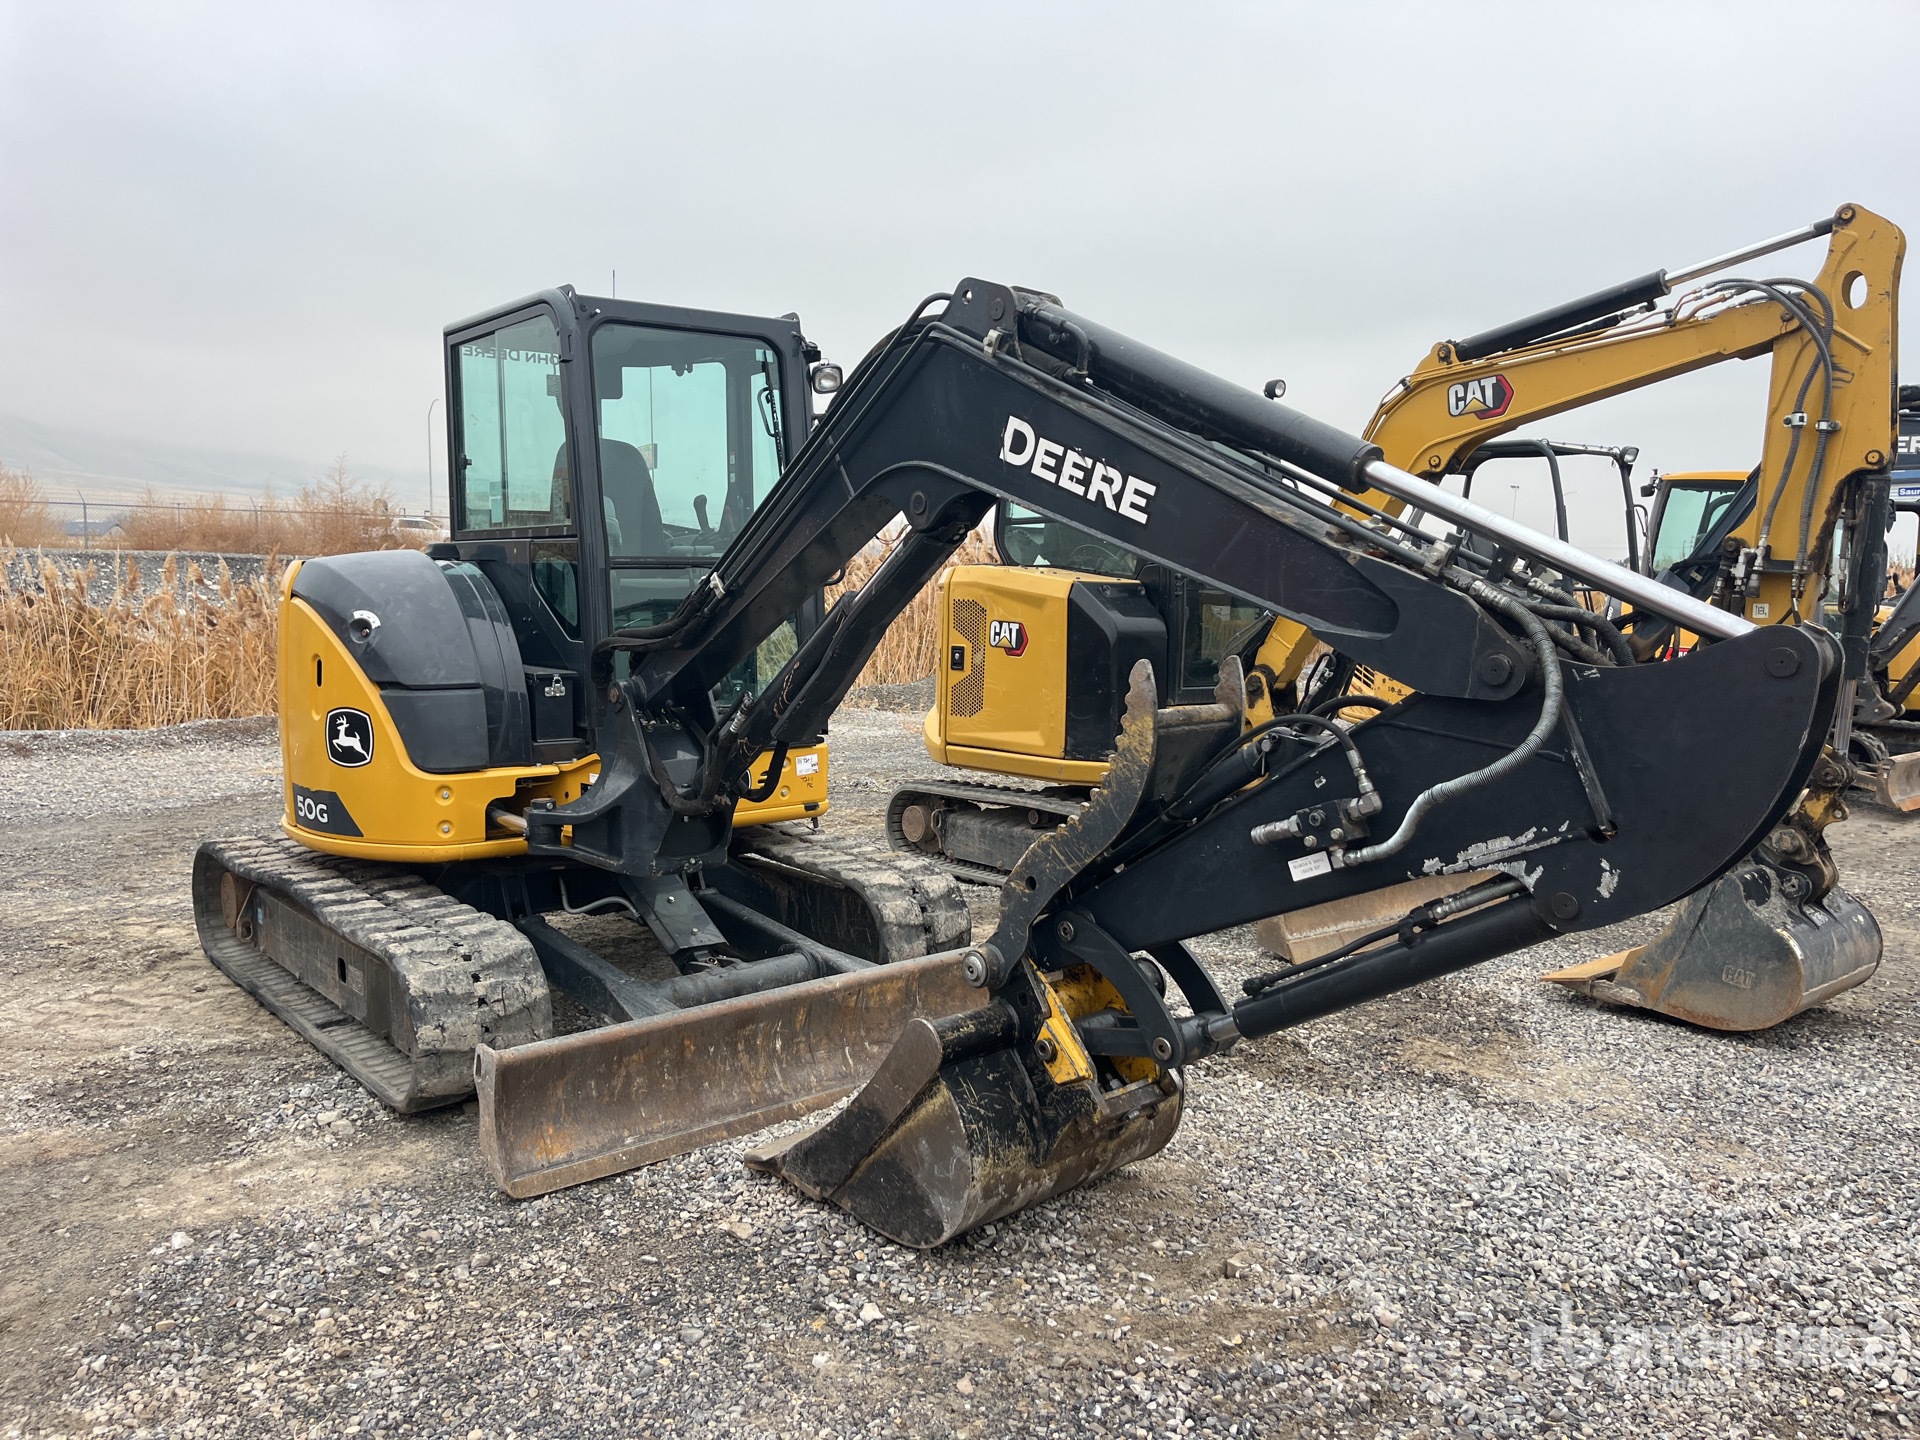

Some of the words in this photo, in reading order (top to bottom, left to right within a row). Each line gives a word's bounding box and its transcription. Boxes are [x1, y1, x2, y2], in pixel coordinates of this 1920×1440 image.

[1448, 376, 1497, 416] CAT
[999, 415, 1157, 525] DEERE
[990, 620, 1020, 649] CAT
[297, 794, 329, 823] 50G
[1722, 965, 1756, 990] CAT
